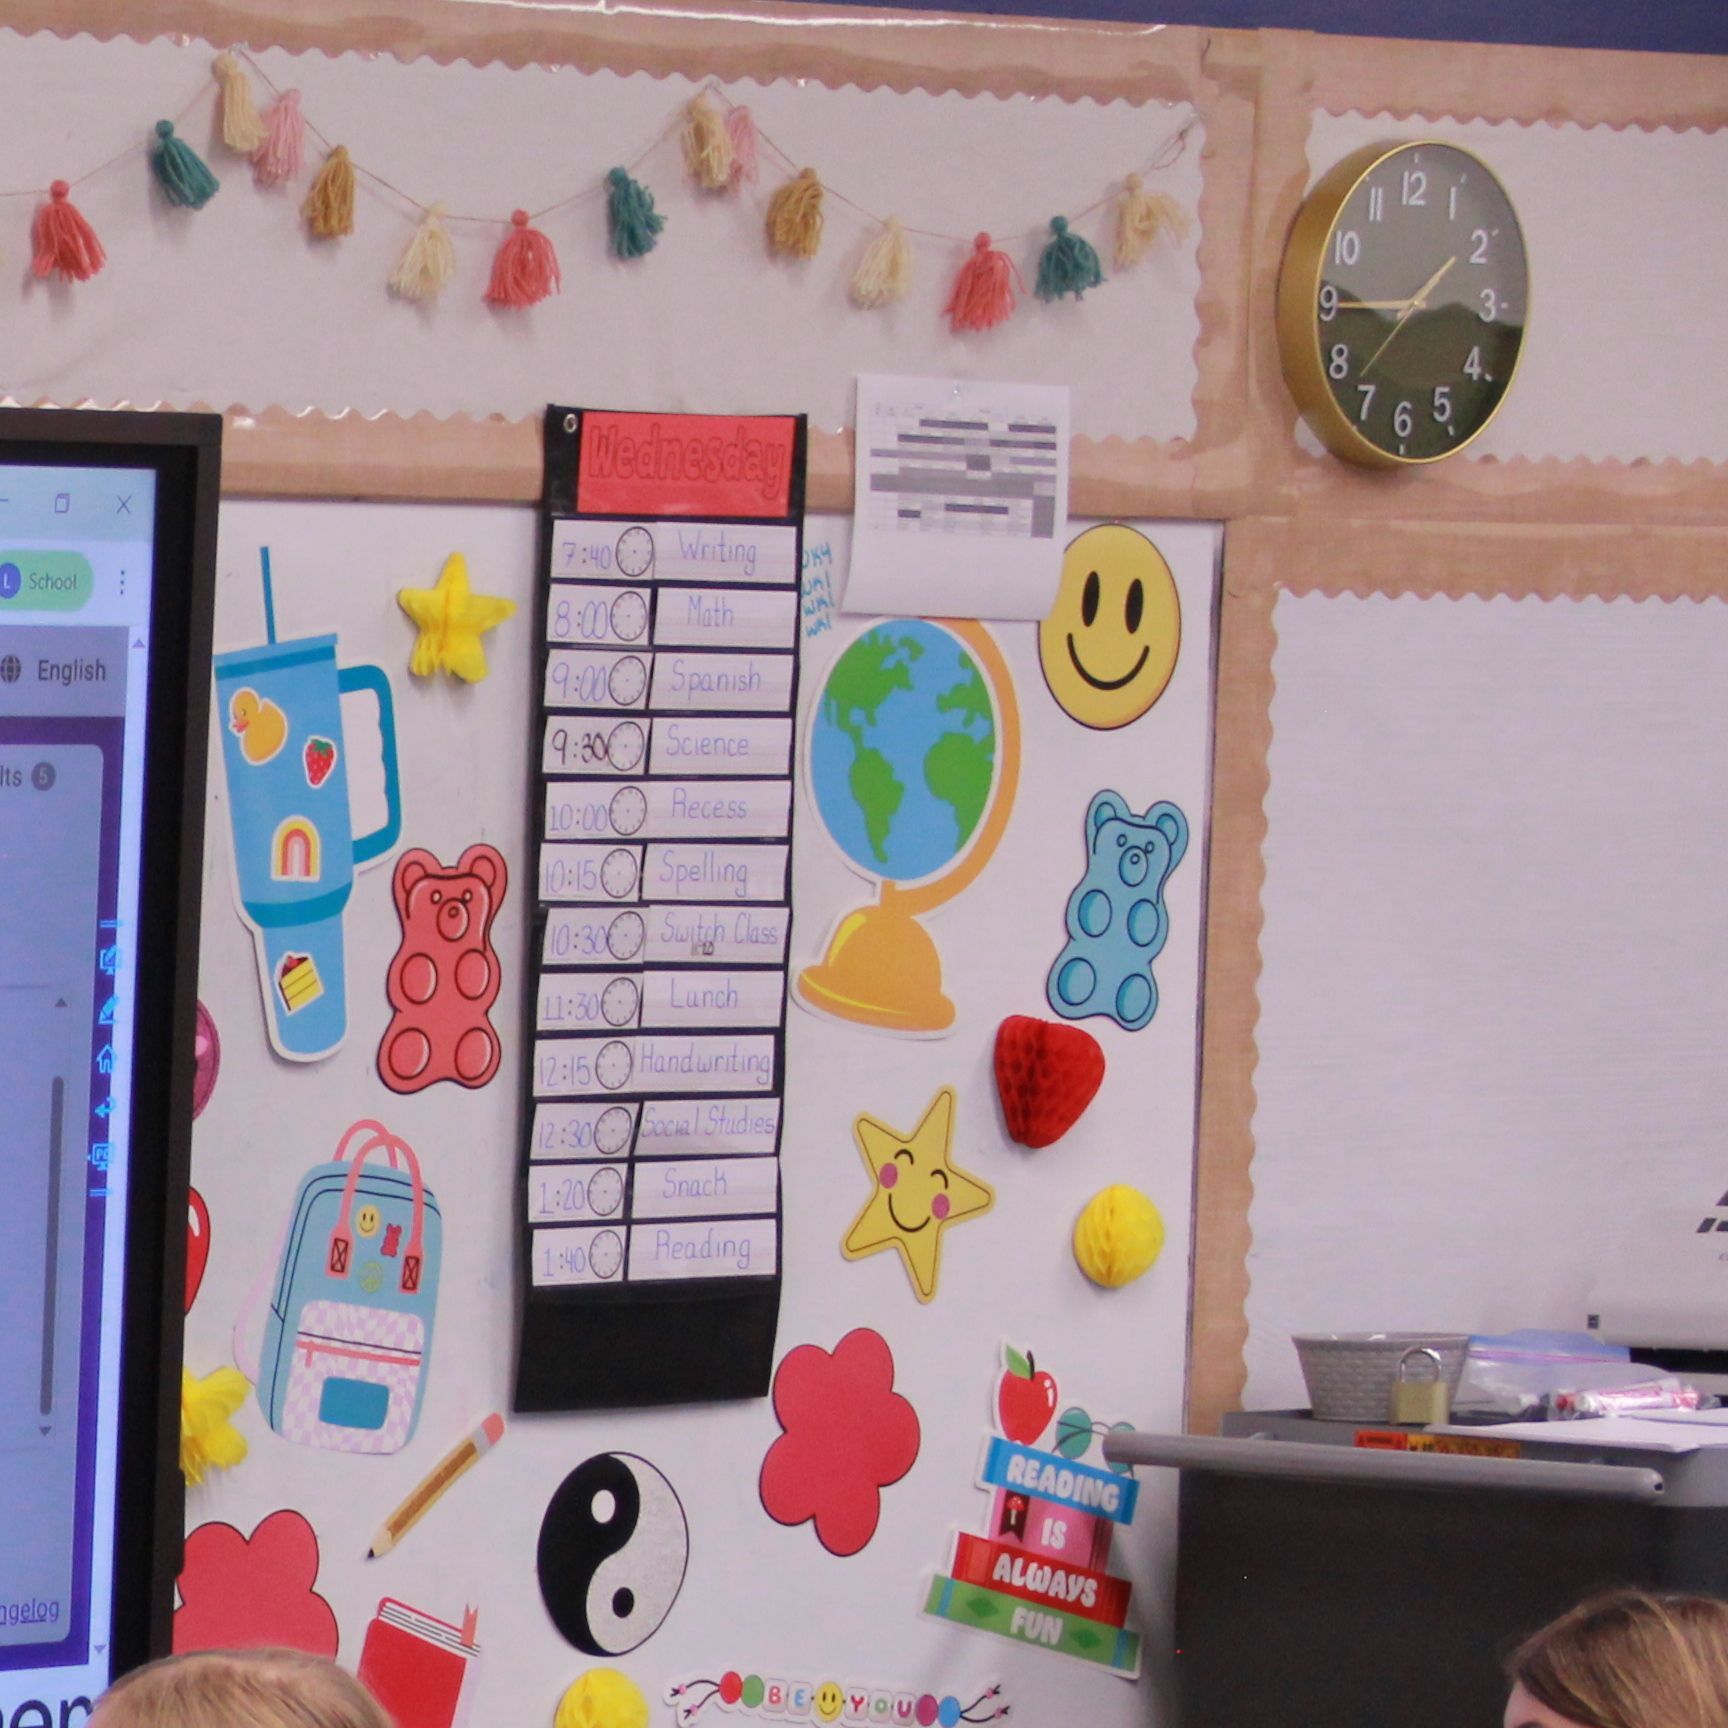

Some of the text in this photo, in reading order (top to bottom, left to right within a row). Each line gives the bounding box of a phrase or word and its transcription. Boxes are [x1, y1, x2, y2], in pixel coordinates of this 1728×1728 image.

[1369, 187, 1383, 222] 11
[1402, 170, 1427, 206] 12
[1449, 186, 1457, 220] 1
[1335, 231, 1361, 265] 10
[1470, 229, 1488, 264] 2
[1319, 285, 1338, 321] 9
[1479, 289, 1496, 322] 3
[1329, 344, 1348, 379] 8
[1463, 346, 1482, 381] 4
[1357, 384, 1376, 420] 7
[1394, 401, 1412, 437] 6
[1433, 387, 1451, 422] 5
[588, 423, 785, 501] Wednesday
[562, 530, 757, 576] 7:40 Writing
[28, 571, 78, 592] School
[555, 595, 734, 639] 8:00 Math
[38, 658, 106, 687] English
[552, 659, 761, 701] 9:00 Spanish
[552, 723, 750, 765] 9:30 Science
[549, 787, 748, 832] 10:00 Recess
[545, 850, 748, 898] 10:15 Spelling
[550, 912, 778, 956] 10:30 Switch Class
[543, 978, 739, 1022] 11:30 Lunch
[539, 1056, 591, 1087] 12:15
[538, 1104, 775, 1149] 12:30 Social Studies
[539, 1166, 728, 1214] 1:20 Snack
[542, 1228, 752, 1277] 1:40 Reading
[1006, 1453, 1120, 1511] READING
[1040, 1517, 1067, 1549] IS
[992, 1552, 1099, 1608] ALWAYS
[1010, 1606, 1064, 1646] FUN
[768, 1685, 913, 1720] BE YOU
